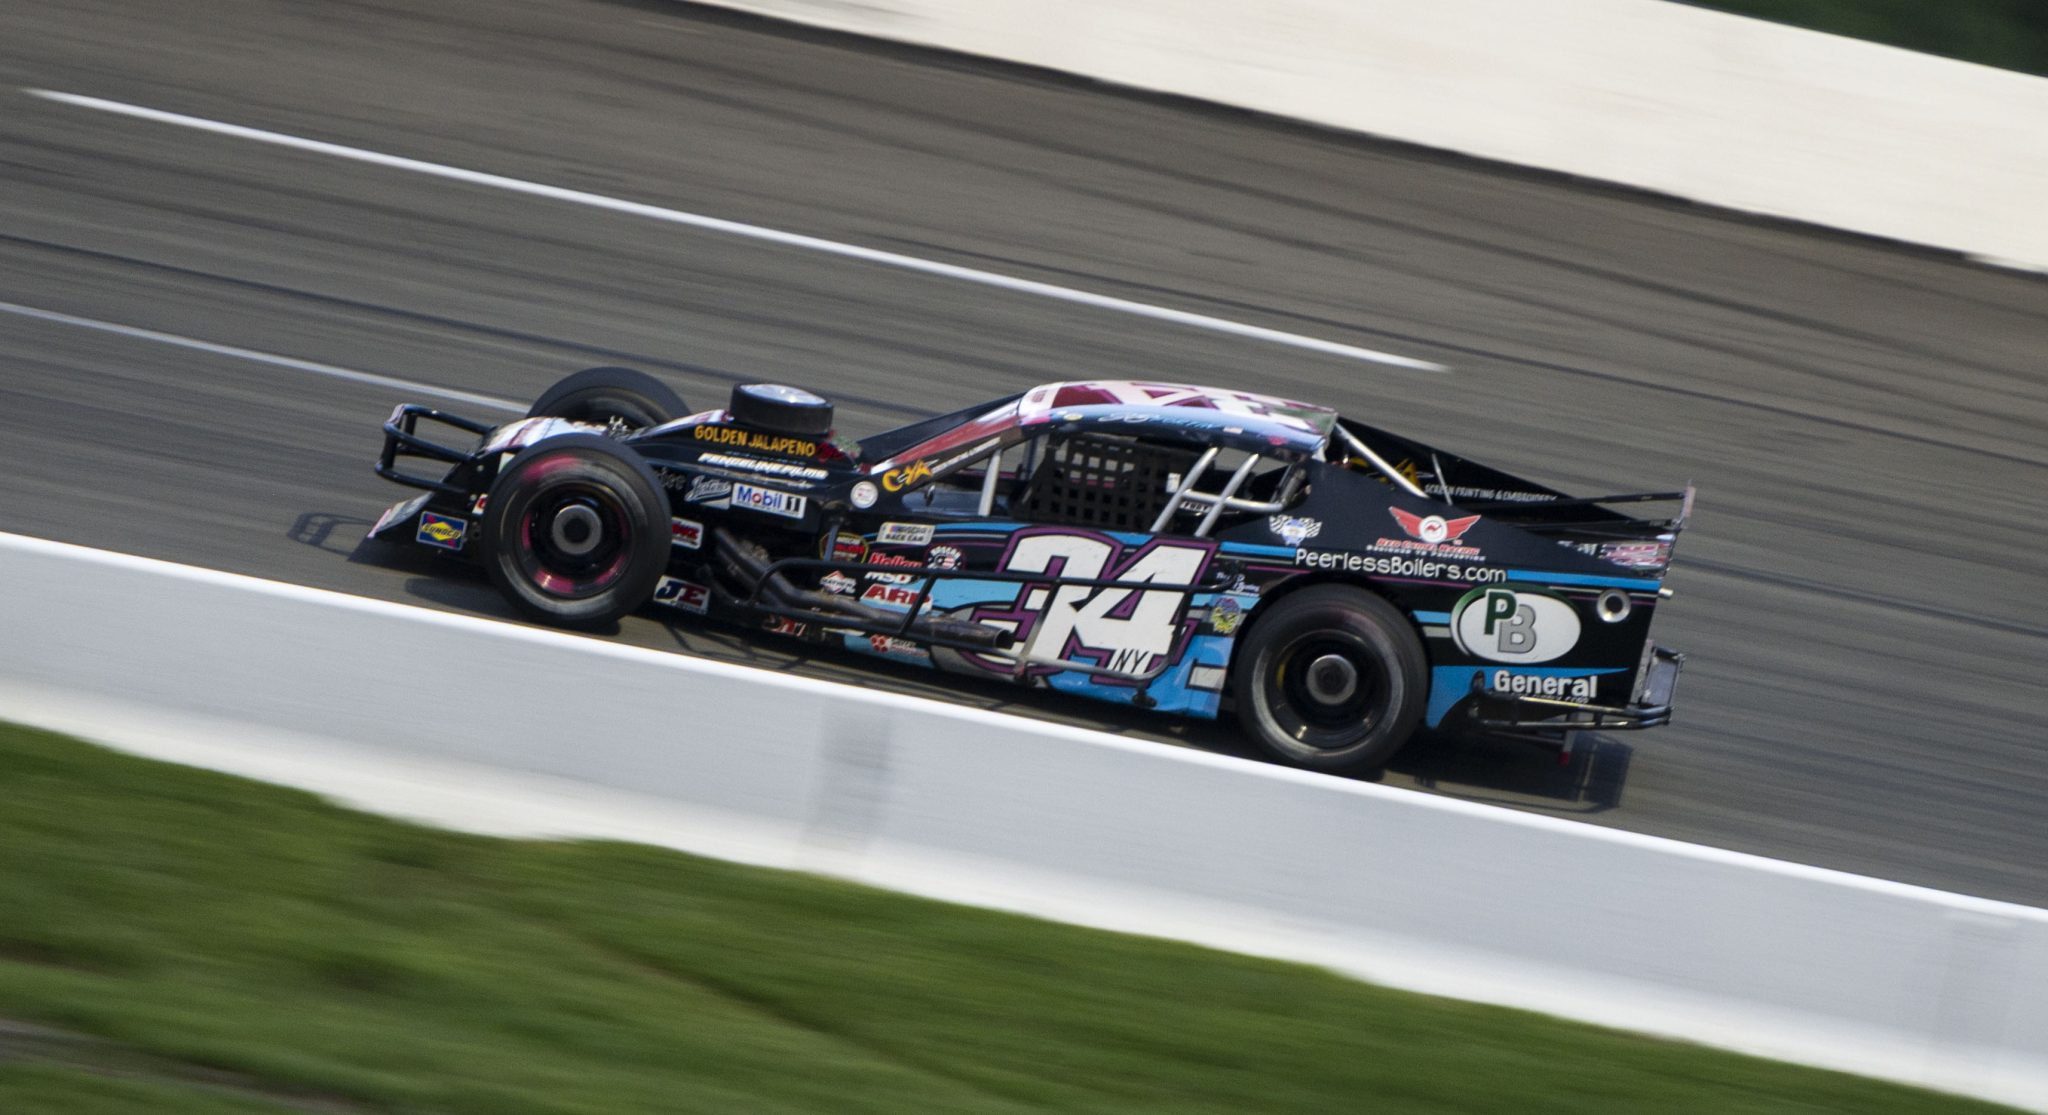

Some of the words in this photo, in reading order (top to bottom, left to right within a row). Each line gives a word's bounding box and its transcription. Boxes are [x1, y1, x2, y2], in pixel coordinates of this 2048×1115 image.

[694, 425, 747, 446] GOLDEN
[738, 486, 782, 510] Mobil
[1296, 548, 1506, 583] PeerlessBoilers.com
[976, 533, 1206, 674] 34
[1113, 648, 1149, 673] NY
[1494, 670, 1598, 698] General
